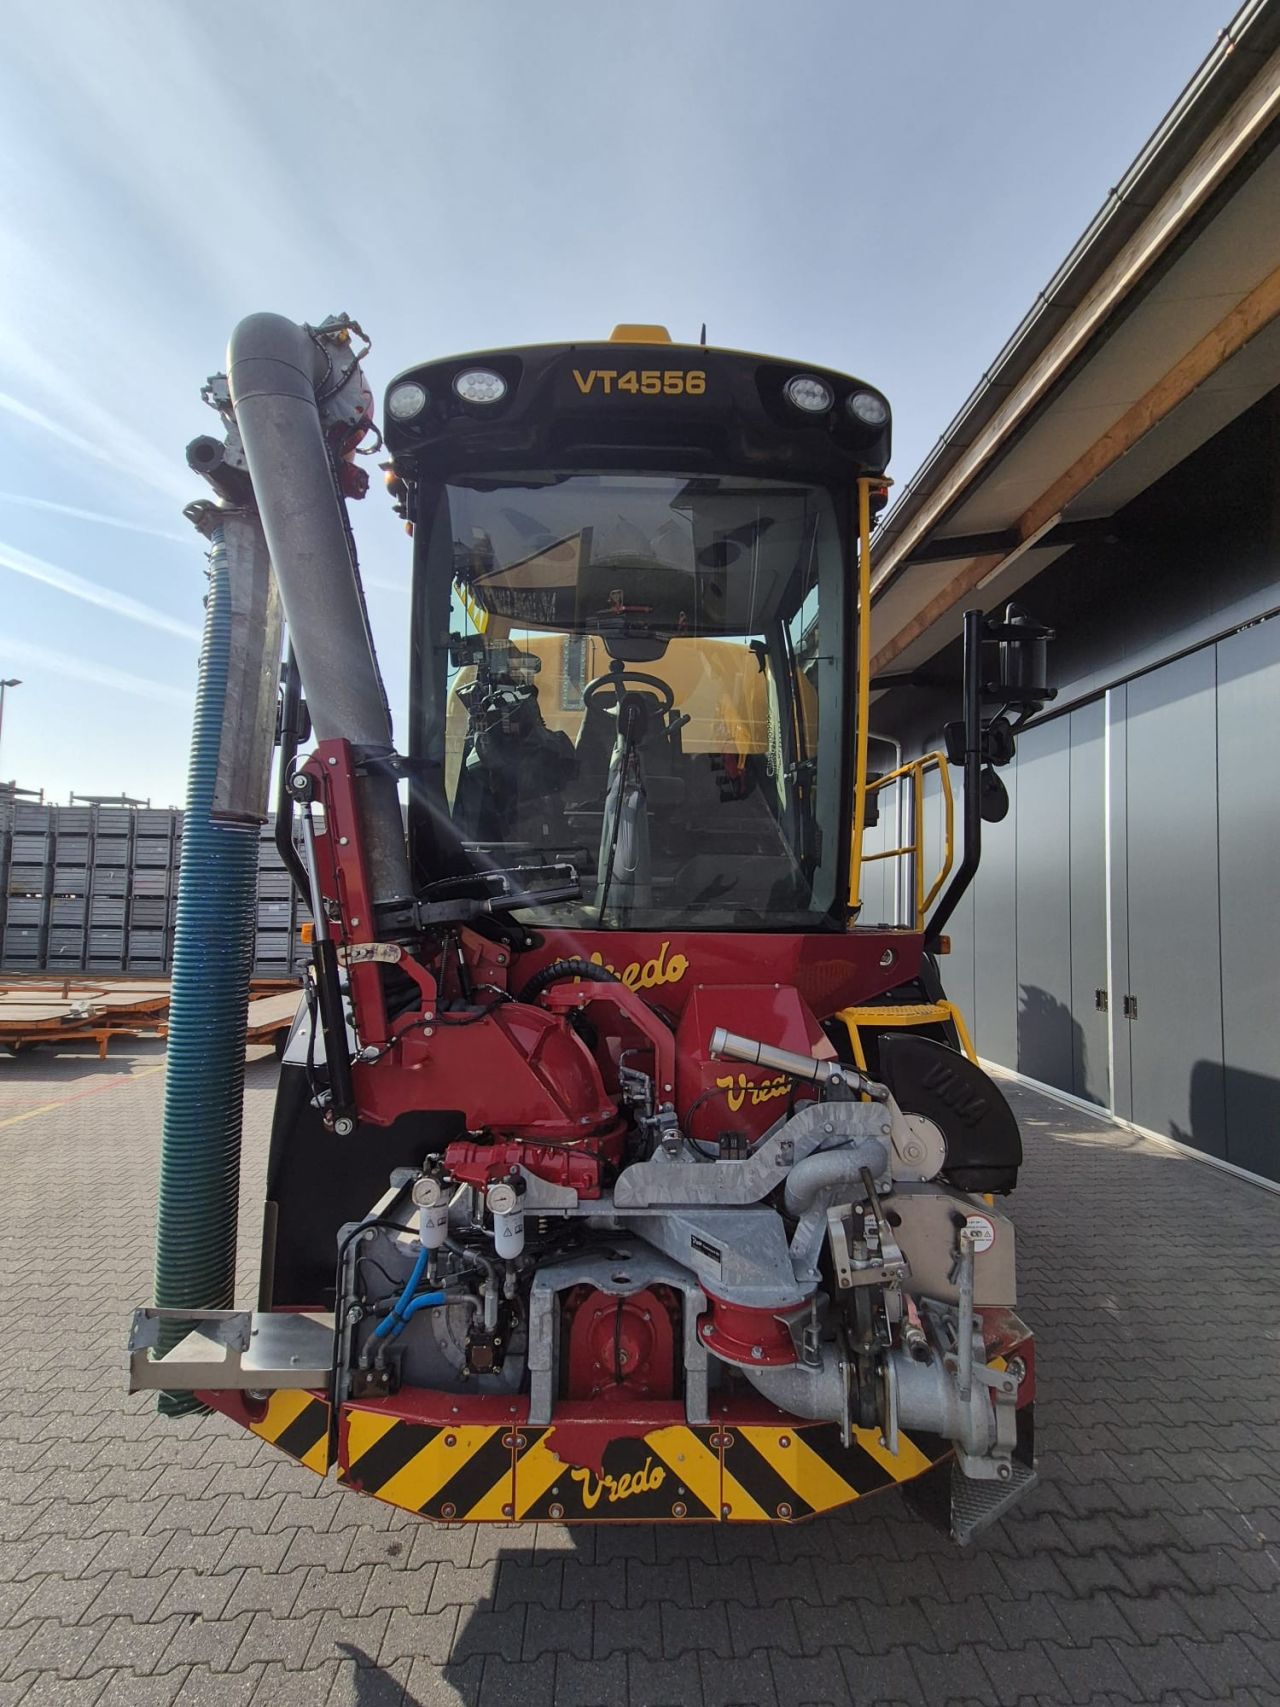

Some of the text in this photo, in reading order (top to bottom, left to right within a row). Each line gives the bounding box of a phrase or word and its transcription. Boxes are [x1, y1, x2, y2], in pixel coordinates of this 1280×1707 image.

[573, 370, 706, 394] VT4556
[554, 941, 689, 1005] edo
[571, 1457, 666, 1510] Vredo
